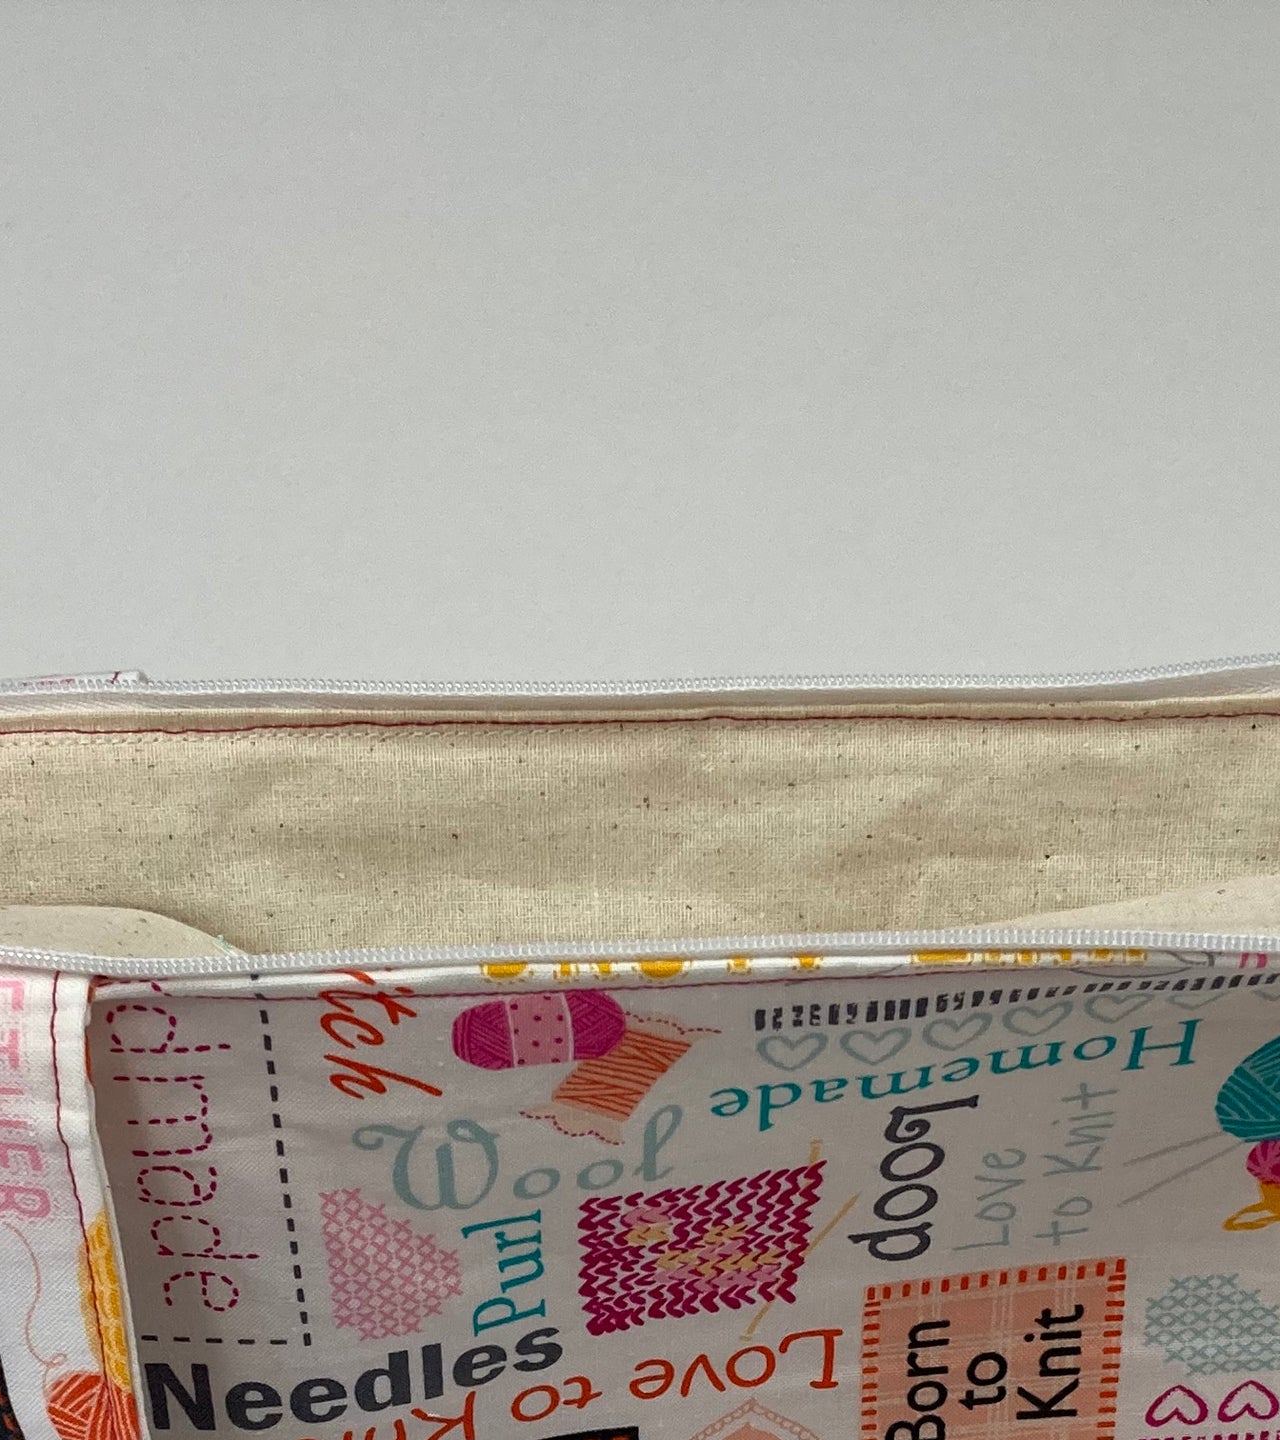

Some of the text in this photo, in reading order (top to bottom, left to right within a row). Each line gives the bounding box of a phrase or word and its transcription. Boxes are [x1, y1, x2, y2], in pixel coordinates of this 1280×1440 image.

[711, 1018, 1205, 1131] Homemade
[353, 1104, 683, 1211] Wool
[848, 1094, 980, 1262] Loop
[952, 1082, 1120, 1252] Love to Knit
[462, 1208, 547, 1336] Purl
[143, 1326, 563, 1434] Needles
[511, 1375, 603, 1422] to
[629, 1328, 843, 1398] Love
[959, 1350, 1009, 1411] to
[1015, 1304, 1085, 1421] Knit
